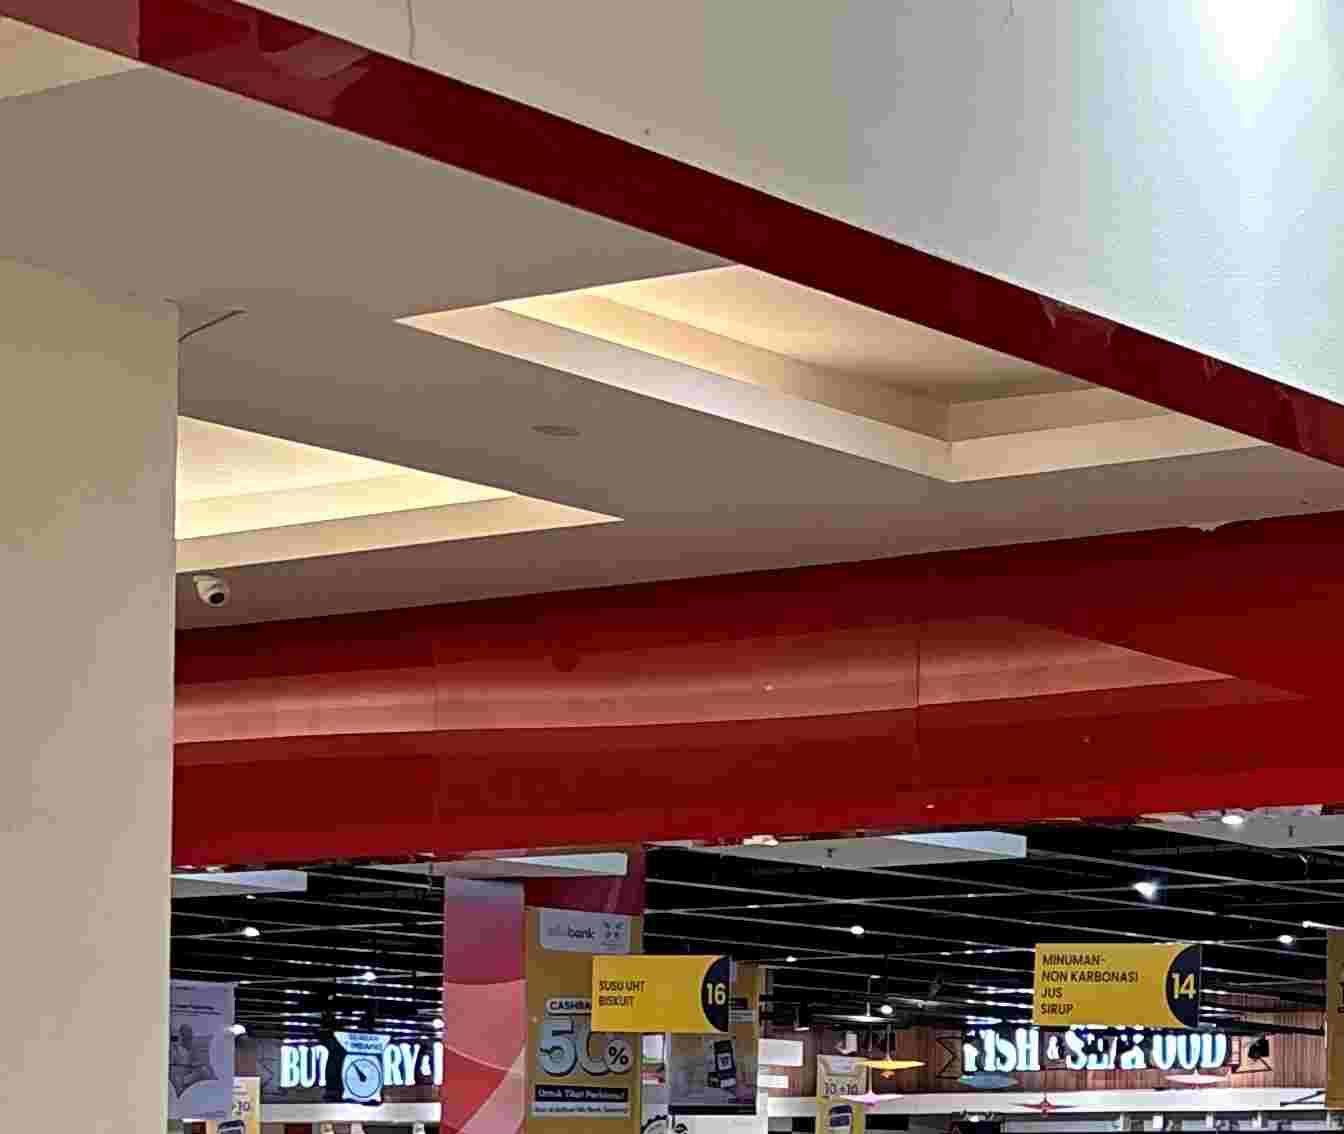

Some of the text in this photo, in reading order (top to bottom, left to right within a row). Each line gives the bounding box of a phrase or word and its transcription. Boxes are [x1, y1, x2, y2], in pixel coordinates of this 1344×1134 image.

[1041, 970, 1139, 984] NON KARBONASI
[625, 980, 646, 993] UHT
[1040, 986, 1063, 999] JUS
[1171, 972, 1197, 1000] 14
[706, 983, 727, 1006] 16
[1040, 1003, 1073, 1016] SIRUP
[1064, 1026, 1227, 1070] SEAOOD
